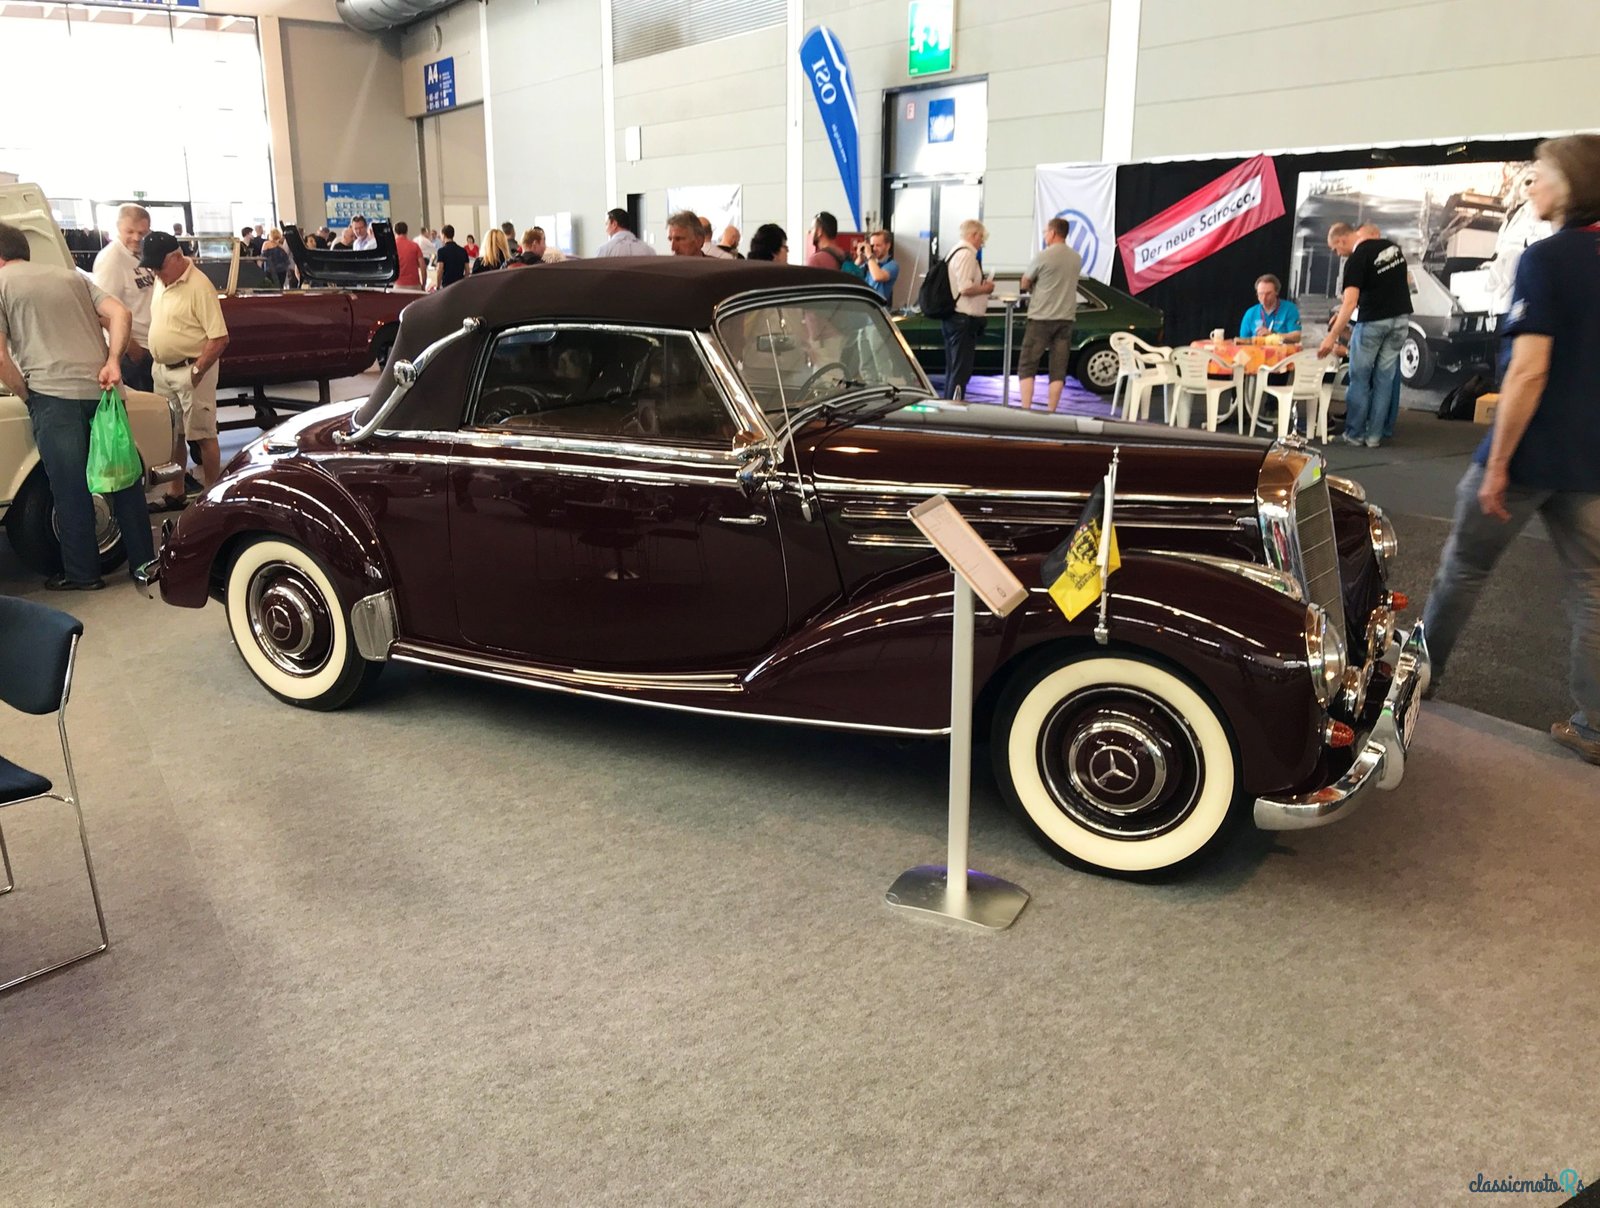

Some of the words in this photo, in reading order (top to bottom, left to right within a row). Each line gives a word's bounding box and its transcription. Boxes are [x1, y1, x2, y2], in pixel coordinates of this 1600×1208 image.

[428, 63, 438, 85] A4
[1141, 244, 1162, 263] Der
[1165, 227, 1195, 252] neue
[1200, 192, 1256, 232] Scirocco.
